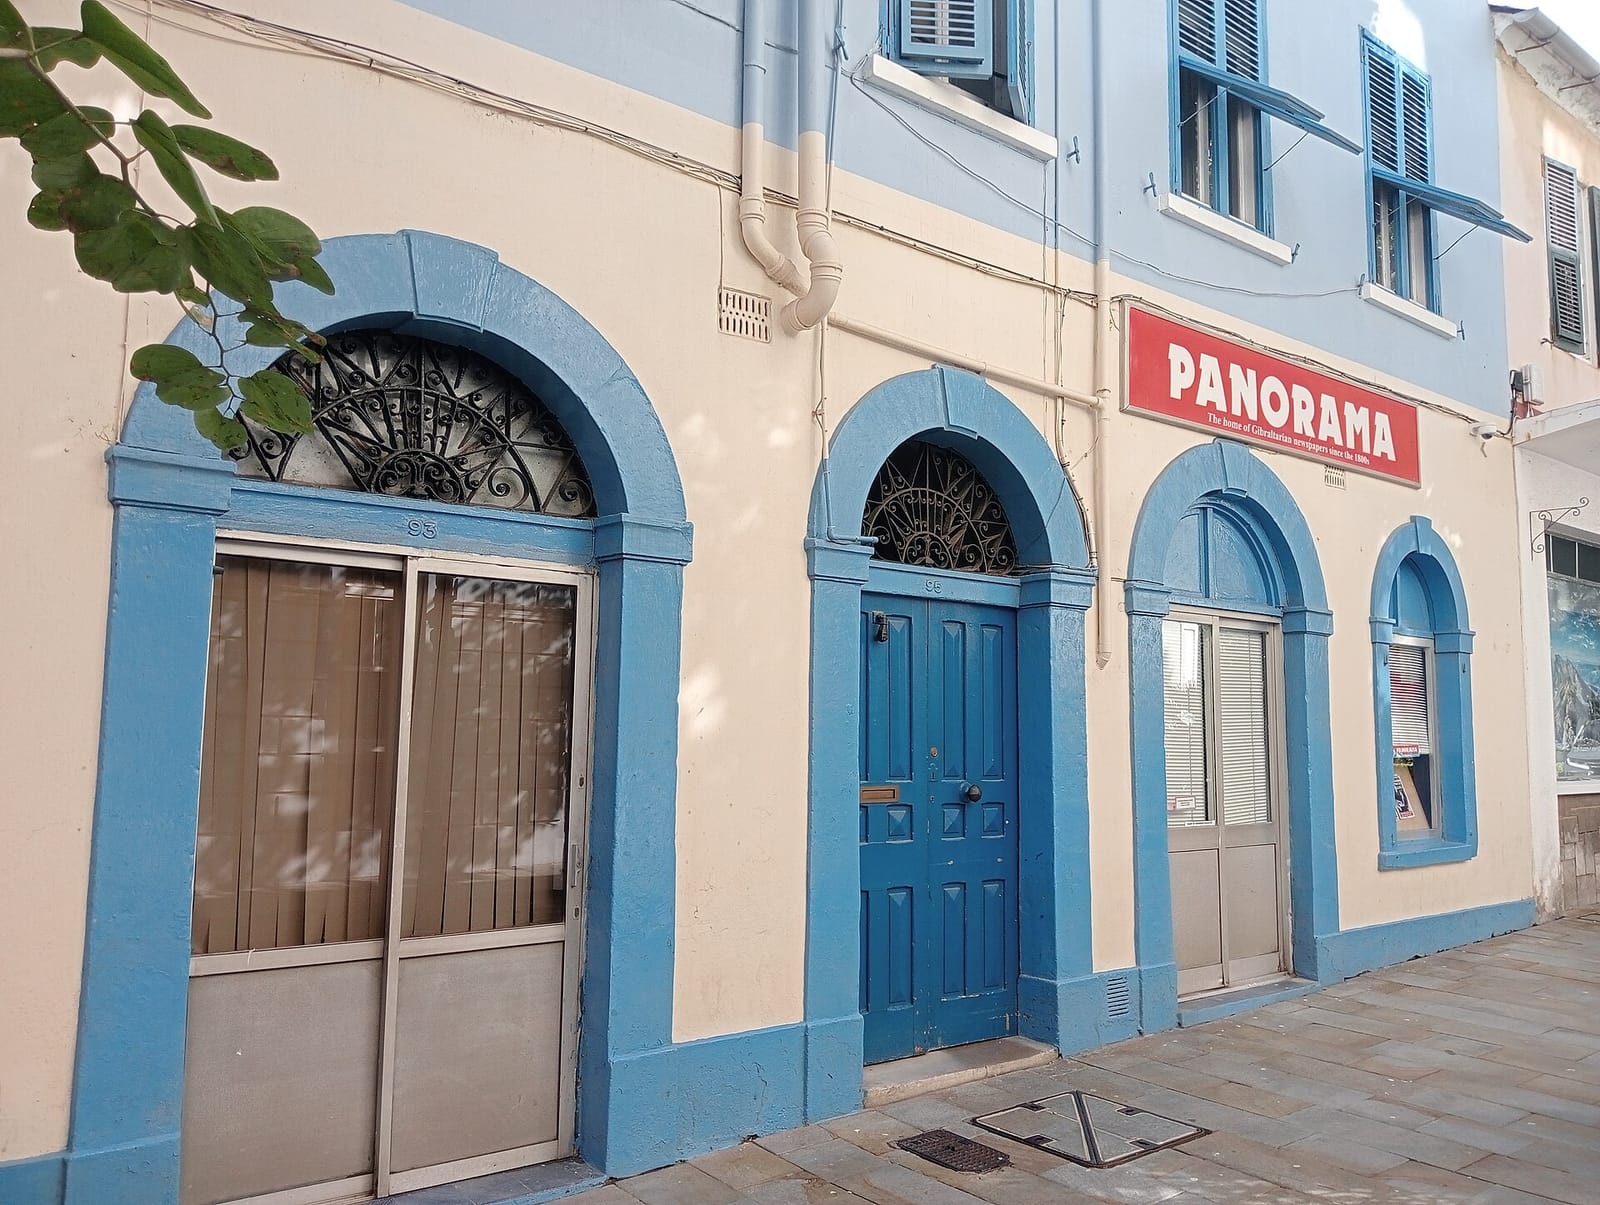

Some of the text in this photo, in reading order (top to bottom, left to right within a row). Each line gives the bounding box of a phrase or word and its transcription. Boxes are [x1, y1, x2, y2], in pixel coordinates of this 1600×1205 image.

[1168, 343, 1396, 462] PANORAMA
[1207, 412, 1370, 465] The home of Gibraltarian newspapers since the 1800s
[407, 519, 438, 539] 93
[925, 579, 943, 594] 95
